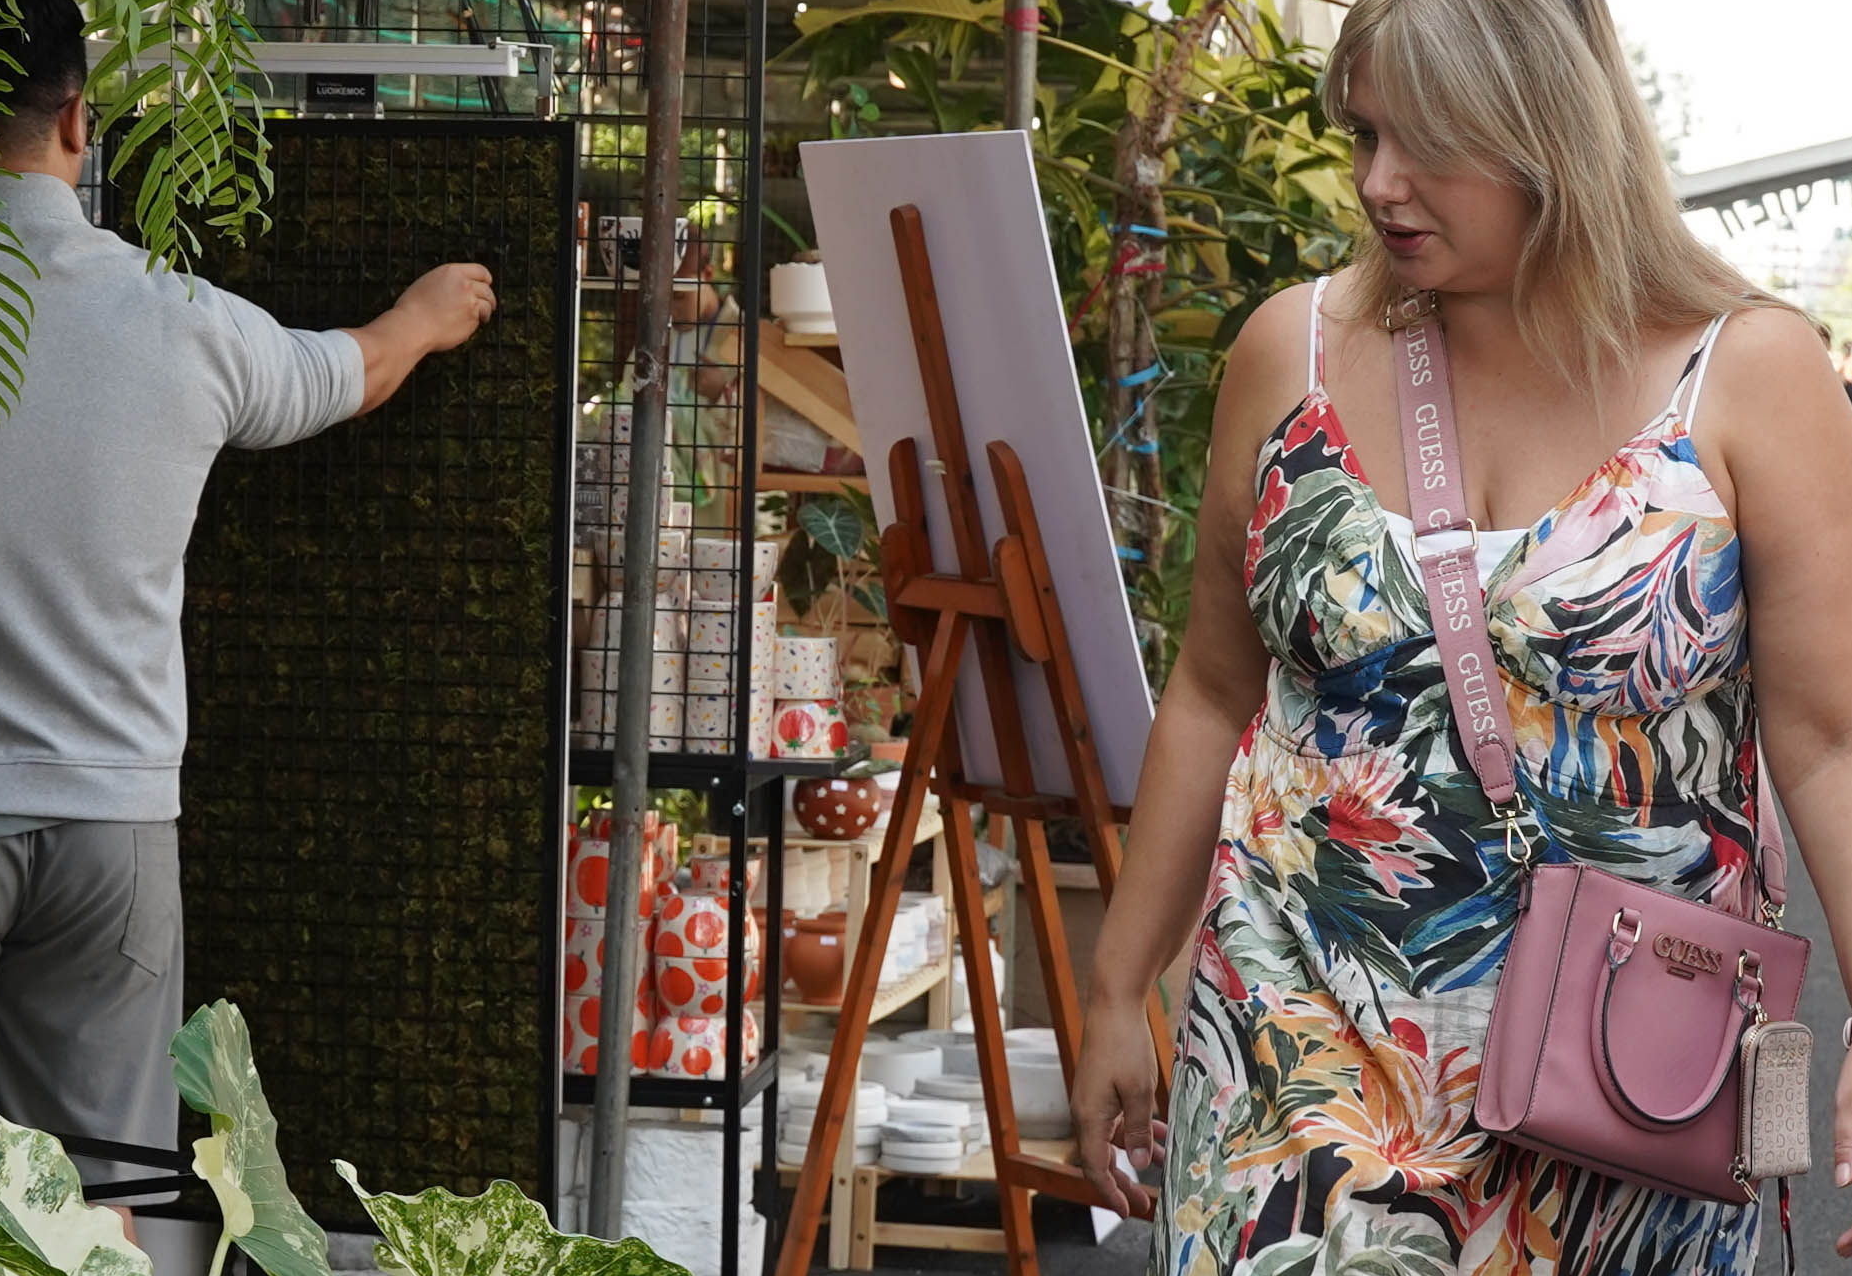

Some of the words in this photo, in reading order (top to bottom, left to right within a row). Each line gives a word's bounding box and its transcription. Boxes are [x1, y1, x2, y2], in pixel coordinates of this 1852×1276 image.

[1414, 402, 1447, 492] GUESS
[1435, 549, 1473, 632] UESS
[1652, 932, 1724, 975] GUESS
